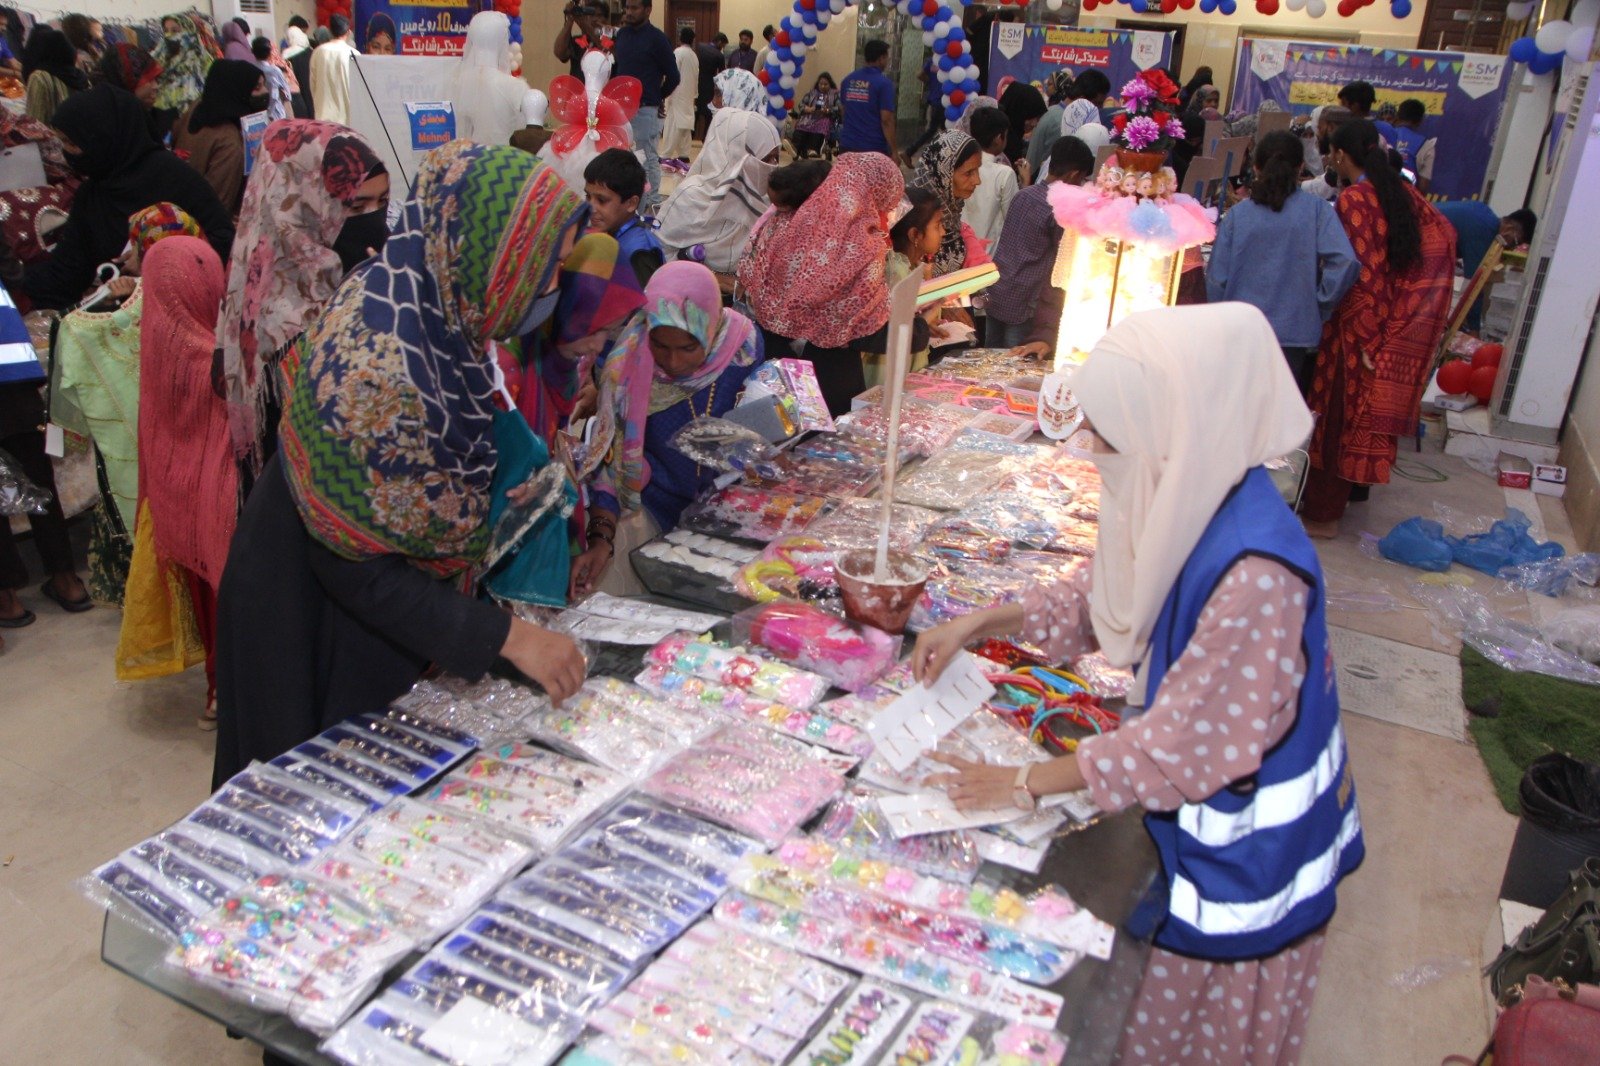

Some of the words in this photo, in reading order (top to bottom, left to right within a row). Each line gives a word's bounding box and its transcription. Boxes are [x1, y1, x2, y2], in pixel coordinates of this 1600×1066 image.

[400, 21, 418, 36] میں
[437, 12, 451, 32] 10
[402, 37, 437, 56] شاپنگ
[1041, 48, 1076, 65] شاپنگ
[1087, 52, 1109, 66] عید
[1475, 63, 1499, 75] SM
[418, 131, 450, 144] Mehndi
